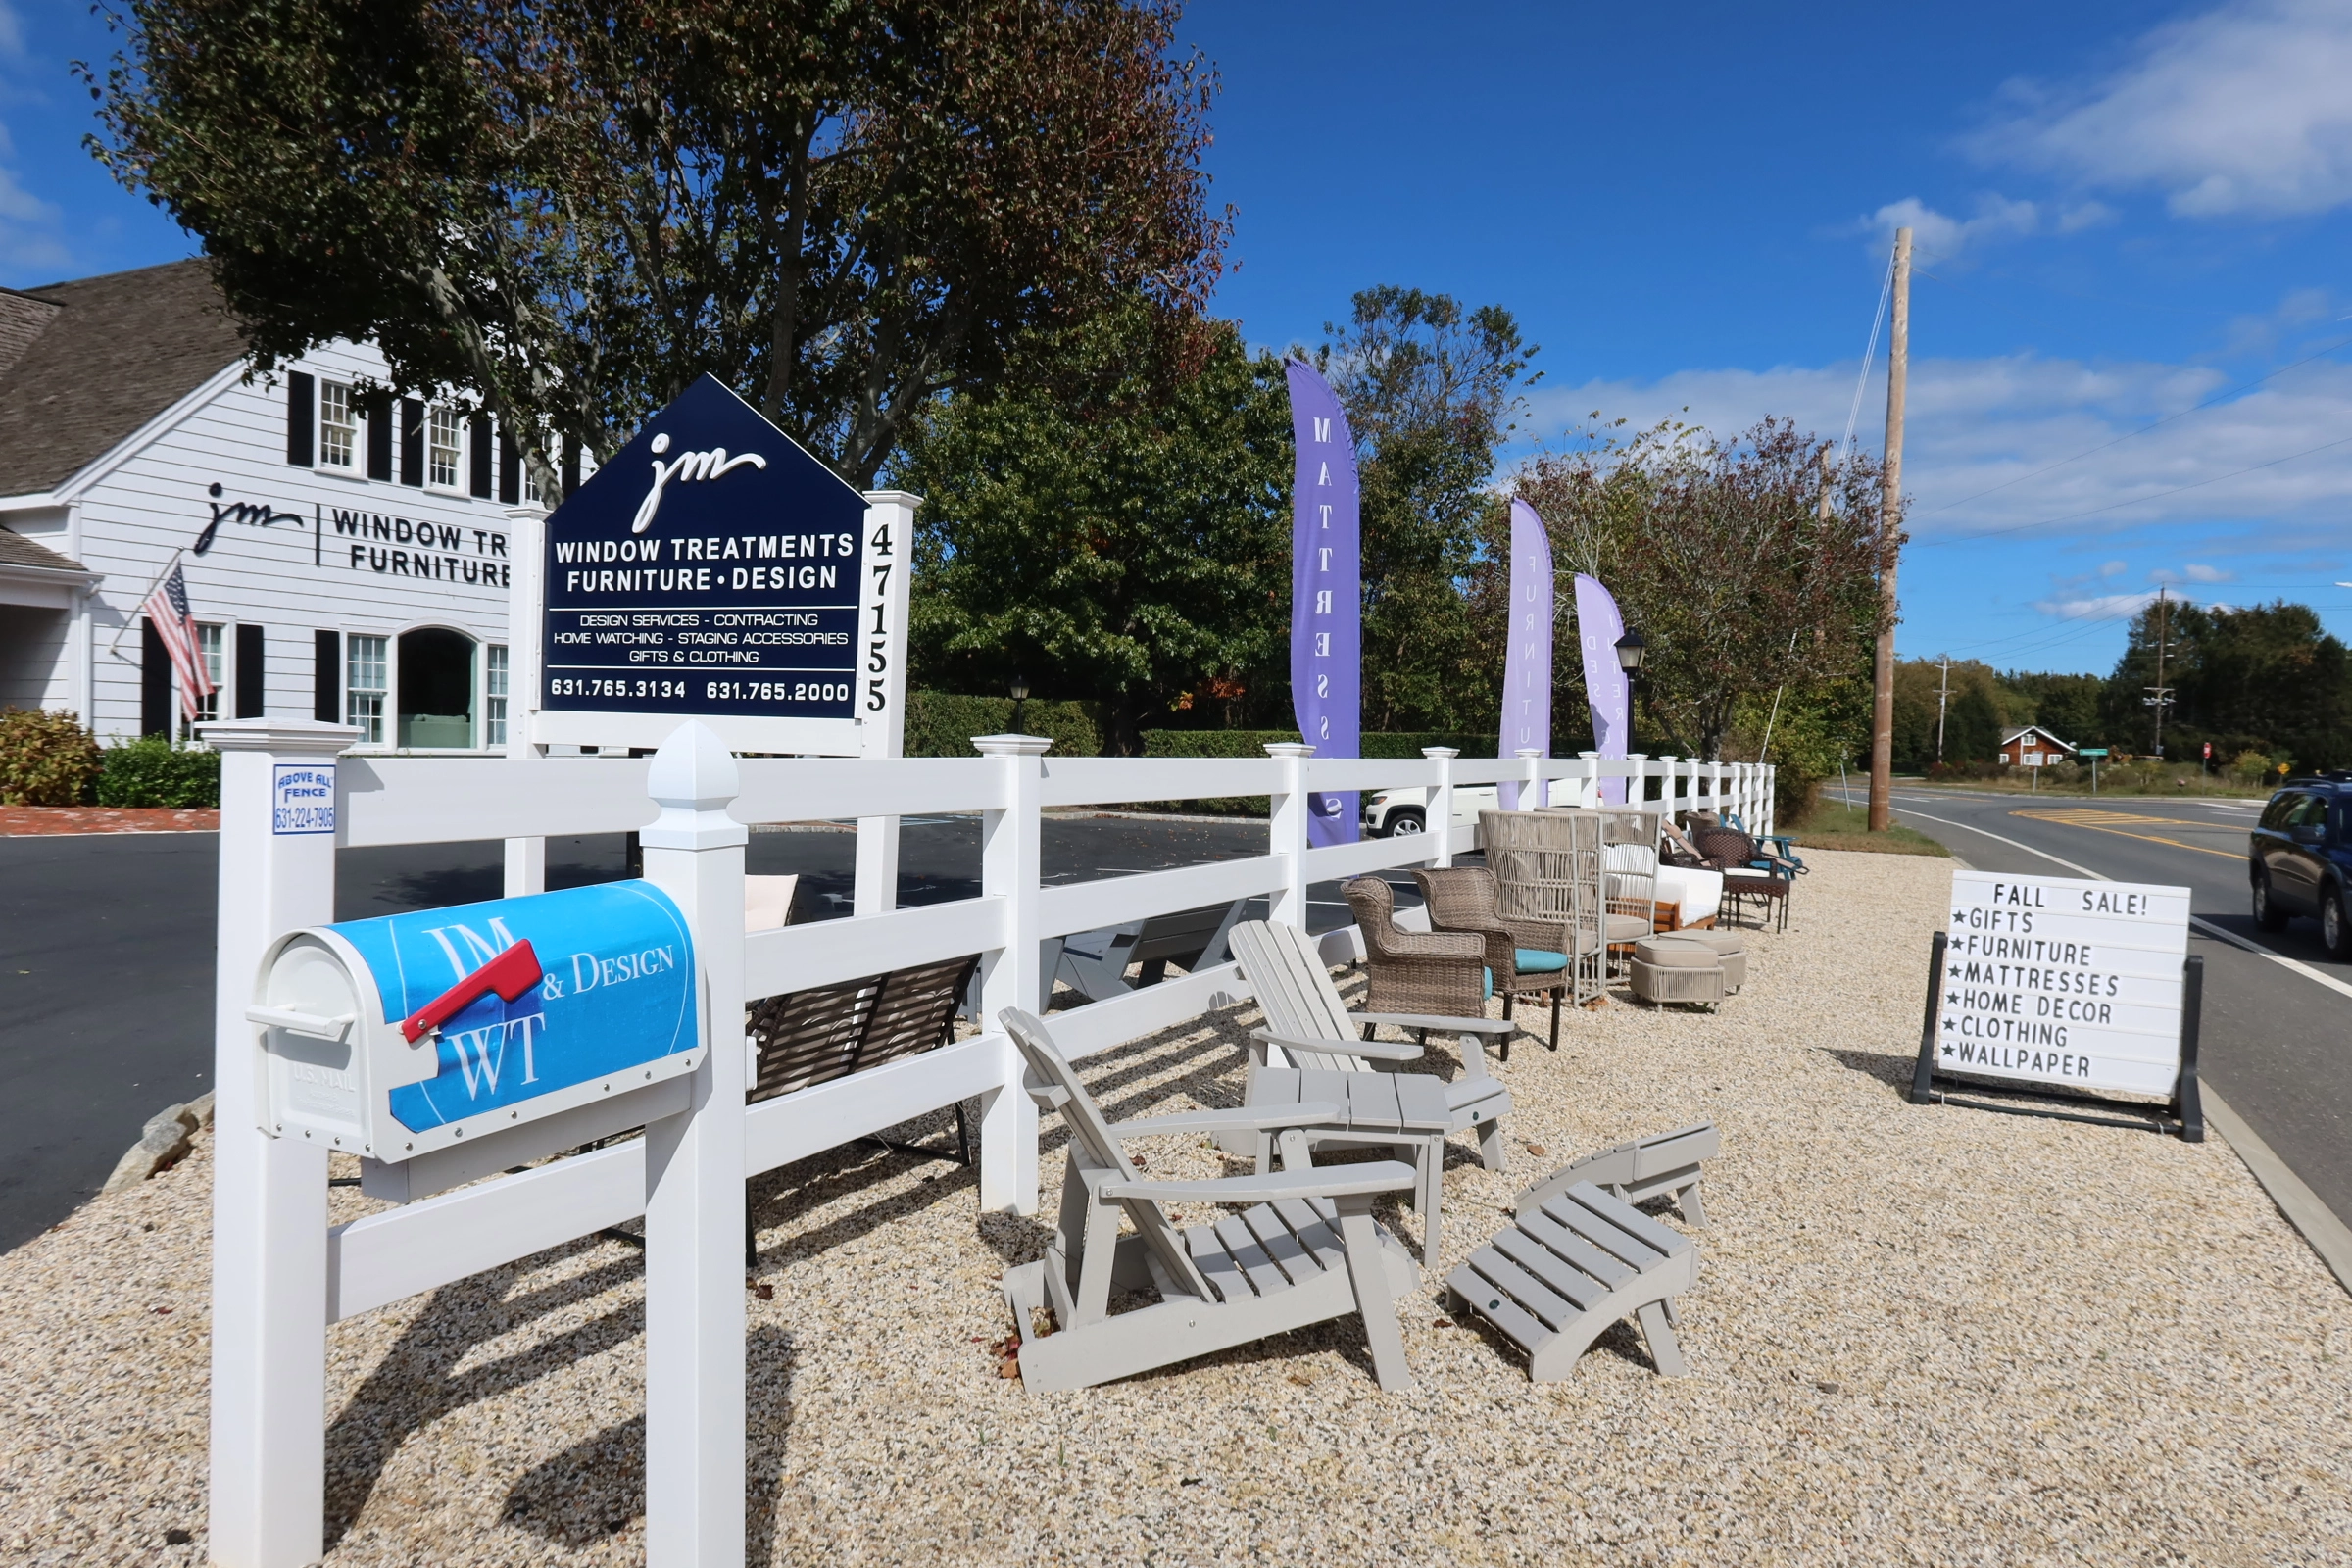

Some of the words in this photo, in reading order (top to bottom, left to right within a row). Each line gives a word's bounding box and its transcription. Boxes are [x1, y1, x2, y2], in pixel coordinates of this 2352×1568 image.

[632, 433, 767, 534] jm
[332, 507, 462, 551] WINDOW
[555, 539, 661, 564] WINDOW
[670, 533, 855, 560] TREATMENTS
[350, 544, 511, 588] FURNITURE
[566, 568, 710, 592] FURNITURE
[732, 565, 837, 590] DESIGN
[579, 614, 628, 627] DESIGN
[632, 614, 700, 627] SERVICES
[713, 613, 818, 627] CONTRACTING
[866, 523, 894, 711] 47155
[553, 632, 591, 644] HOME
[595, 632, 663, 645] WATCHING
[677, 632, 738, 645] STAGING
[742, 632, 849, 645] ACCESSORIES
[628, 650, 668, 662] GIFTS
[672, 650, 685, 662] &
[689, 650, 760, 662] CLOTHING
[550, 678, 686, 698] 631.765.3134
[706, 681, 850, 702] 631.765.2000
[278, 771, 313, 789] ABOVE
[316, 773, 332, 789] ALL
[284, 788, 327, 803] FENCE
[275, 807, 334, 829] 631-224-7905
[1993, 883, 2045, 907] FALL
[2082, 890, 2147, 916] SALE!
[1969, 907, 2034, 933] GIFTS
[1967, 935, 2091, 966] FURNITURE
[541, 972, 566, 1001] &
[1964, 961, 2119, 997] MATTRESSES
[1963, 988, 2023, 1015] HOME
[2037, 995, 2112, 1025] DECOR
[1961, 1015, 2068, 1048] CLOTHING
[445, 1011, 547, 1102] WT
[1959, 1041, 2090, 1078] WALLPAPER
[320, 1068, 356, 1093] MAIL
